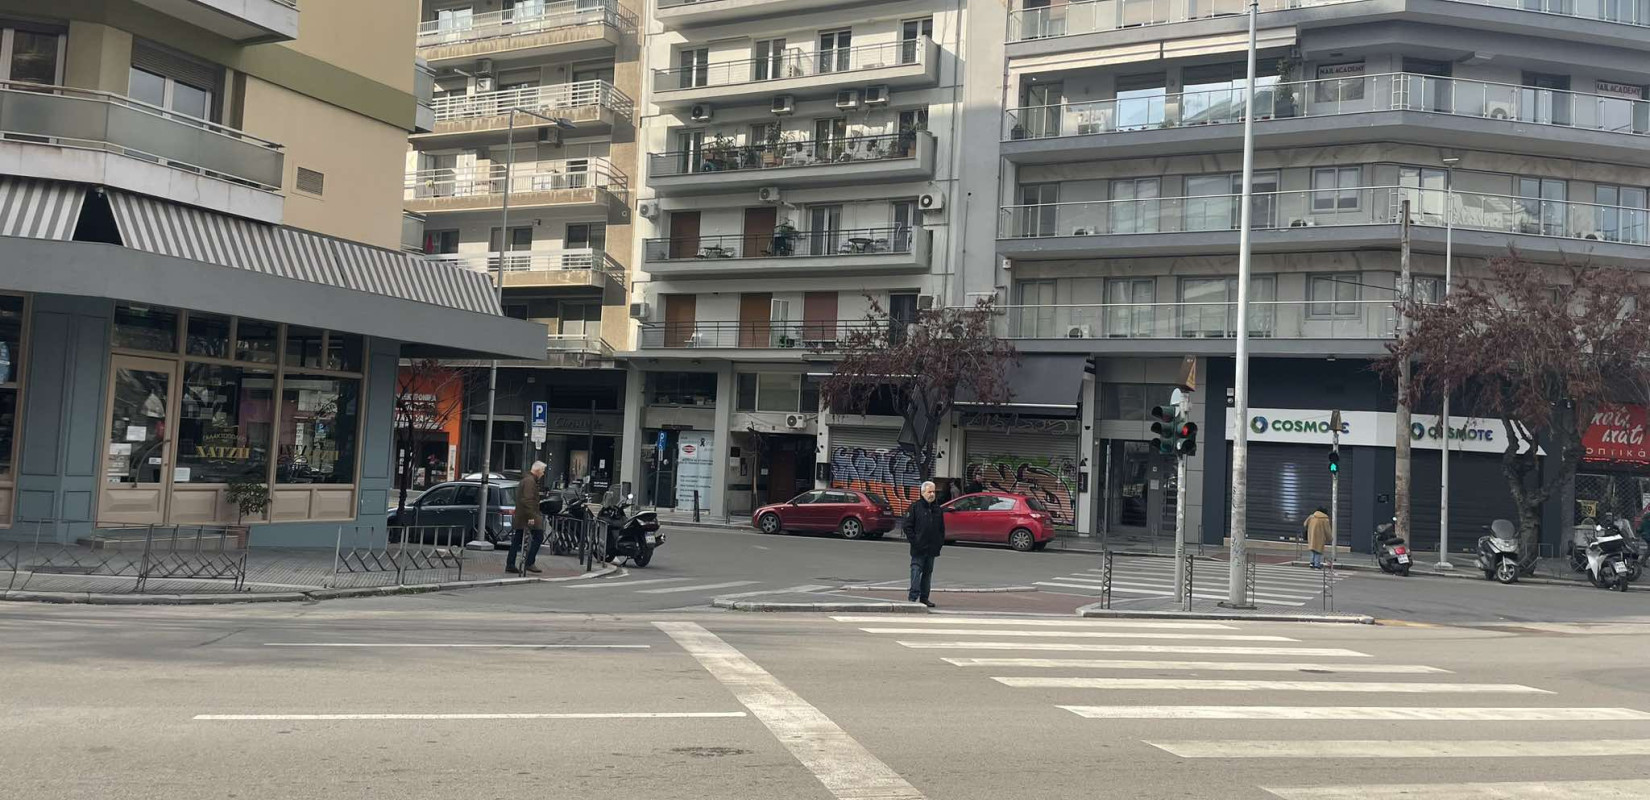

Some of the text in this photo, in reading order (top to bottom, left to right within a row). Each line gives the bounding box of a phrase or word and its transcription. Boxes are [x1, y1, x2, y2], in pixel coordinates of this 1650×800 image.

[1320, 65, 1364, 75] NAIL ACADEMY
[1610, 85, 1640, 95] ACADEMY
[536, 404, 543, 418] P
[1272, 419, 1350, 434] COSMOE
[1428, 426, 1493, 441] CSMOTE
